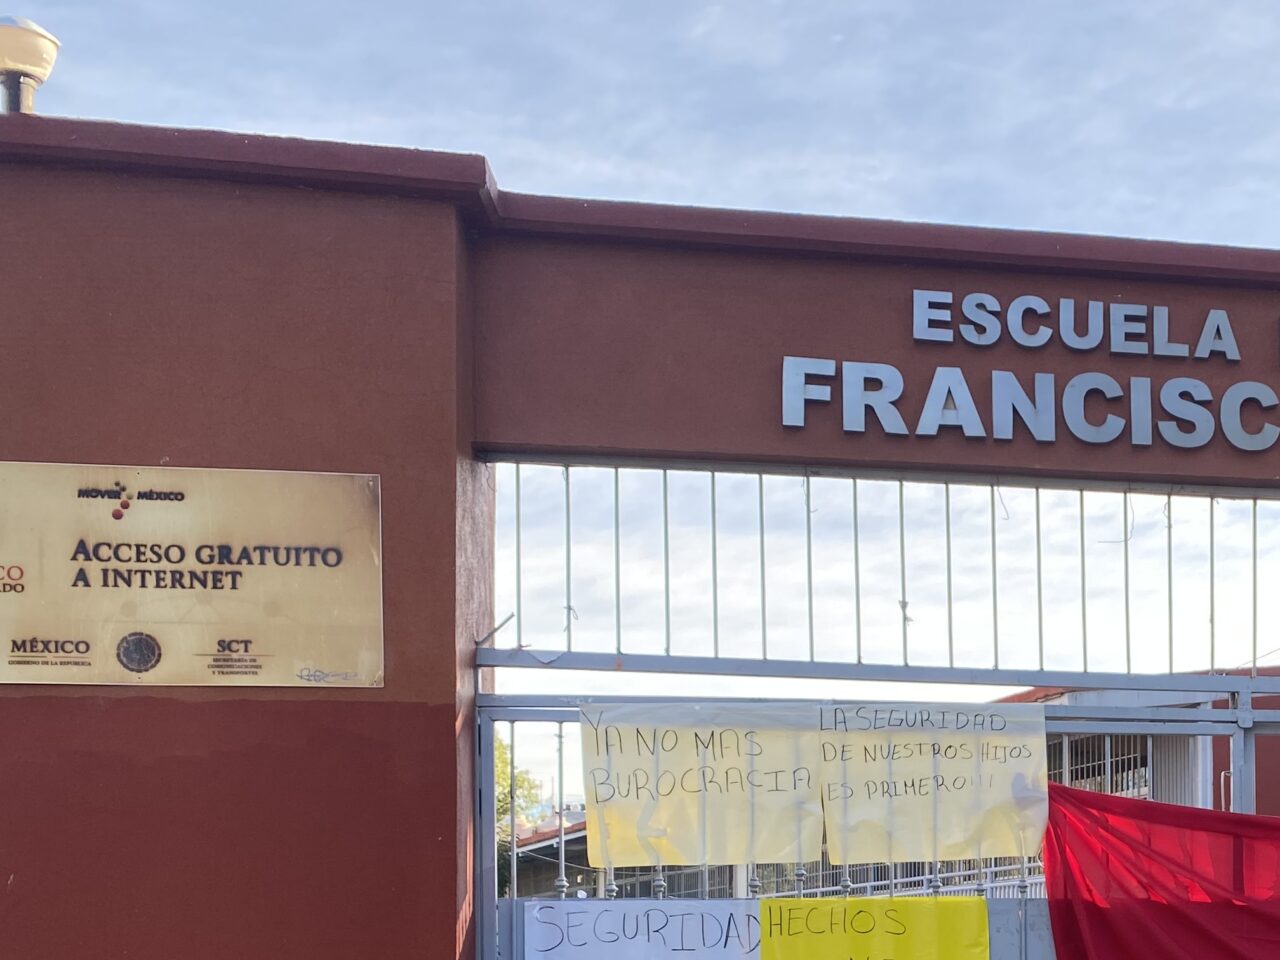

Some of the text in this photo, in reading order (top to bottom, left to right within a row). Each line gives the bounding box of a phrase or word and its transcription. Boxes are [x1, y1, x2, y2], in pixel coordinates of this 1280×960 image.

[912, 288, 1242, 362] ESCUELA
[77, 488, 122, 500] MOVER
[69, 538, 344, 569] ACCESO GRATUITO
[0, 583, 25, 593] DO
[71, 568, 243, 590] A INTERNET
[10, 637, 91, 654] MÉXICO
[217, 639, 252, 653] SCT
[819, 706, 1007, 732] LA SEGURIDAD
[582, 709, 763, 762] YA NO MAS
[822, 741, 1032, 764] DE NUESTROS HIJOS
[589, 765, 812, 805] BUROCRACIA
[827, 781, 854, 802] ES
[535, 905, 761, 955] SEGURIDAD
[768, 905, 907, 938] HECHOS
